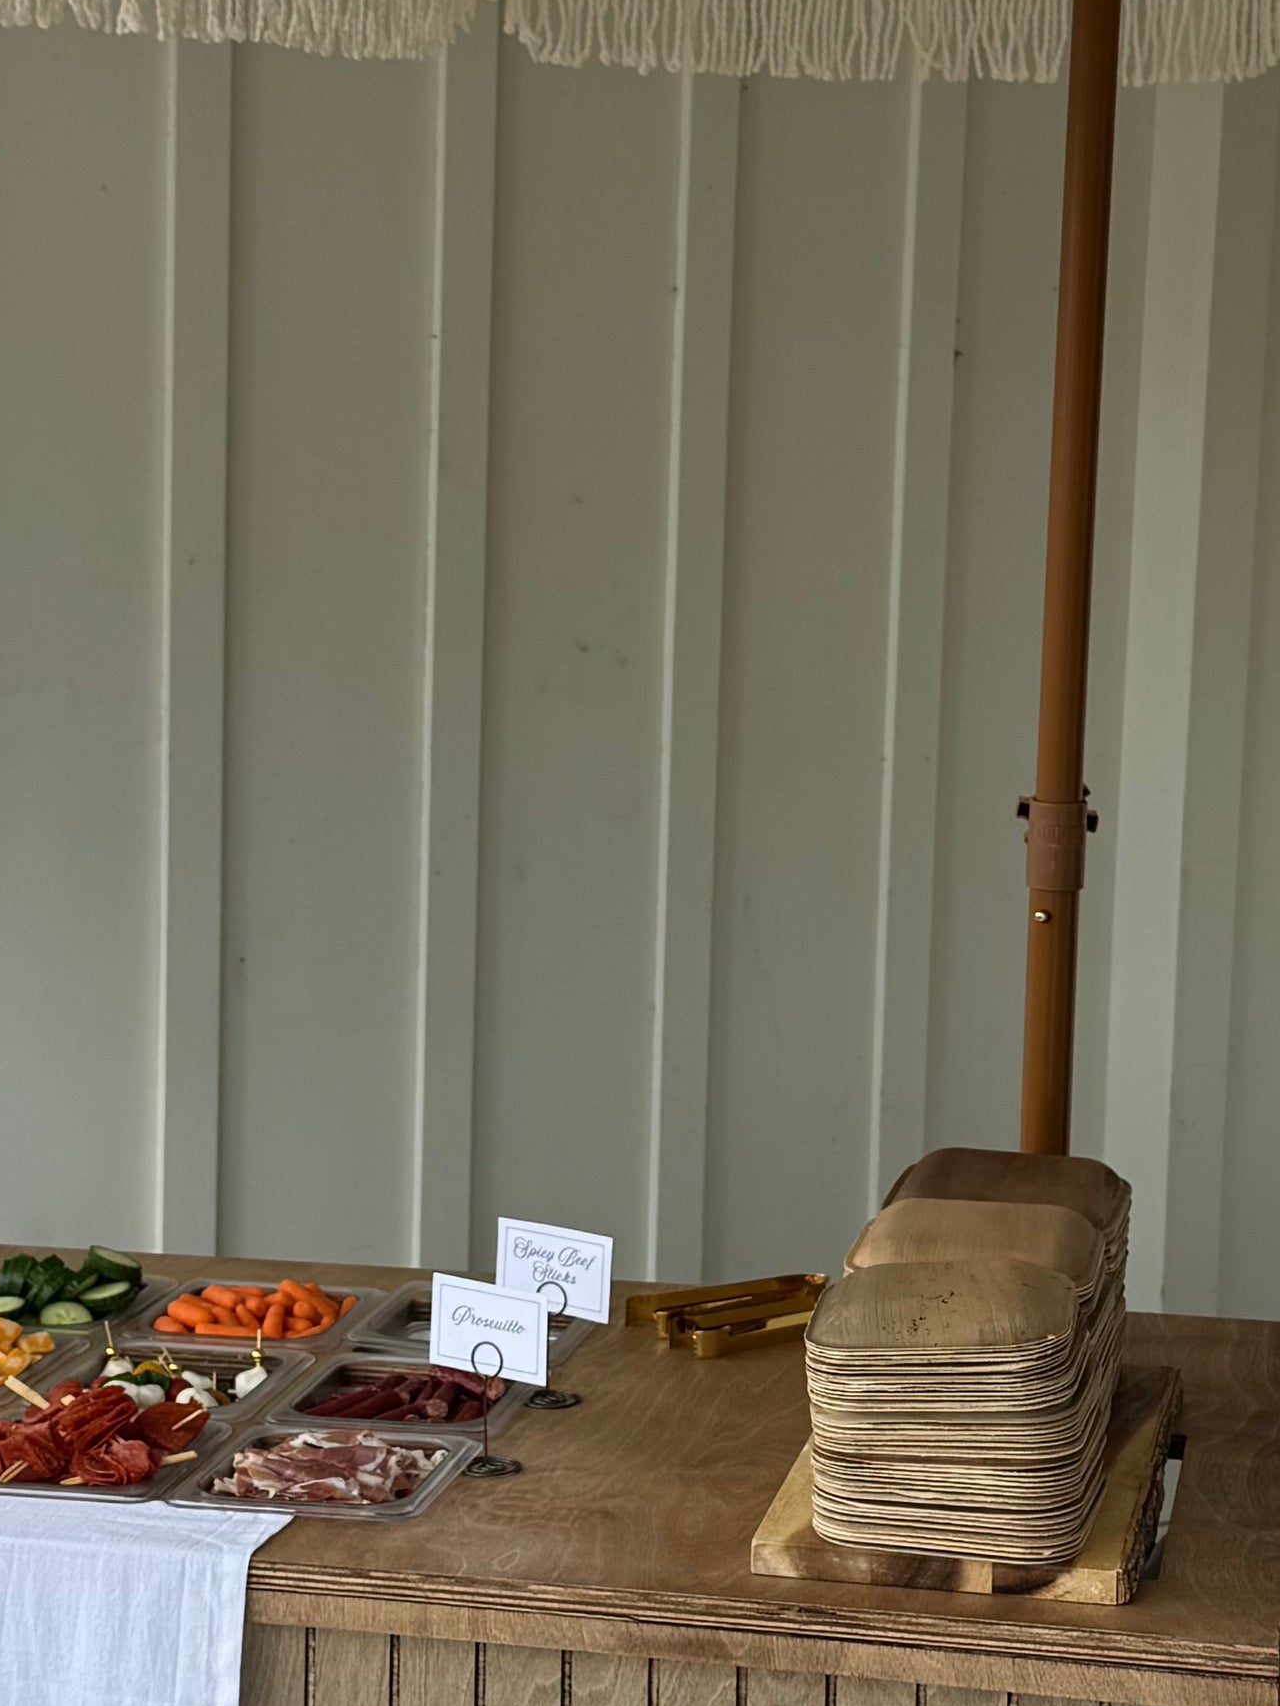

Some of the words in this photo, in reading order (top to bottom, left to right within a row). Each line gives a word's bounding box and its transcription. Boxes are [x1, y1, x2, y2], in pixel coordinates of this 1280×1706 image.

[513, 1236, 556, 1263] Spicy
[558, 1246, 599, 1271] Beef
[532, 1260, 577, 1285] Sticks
